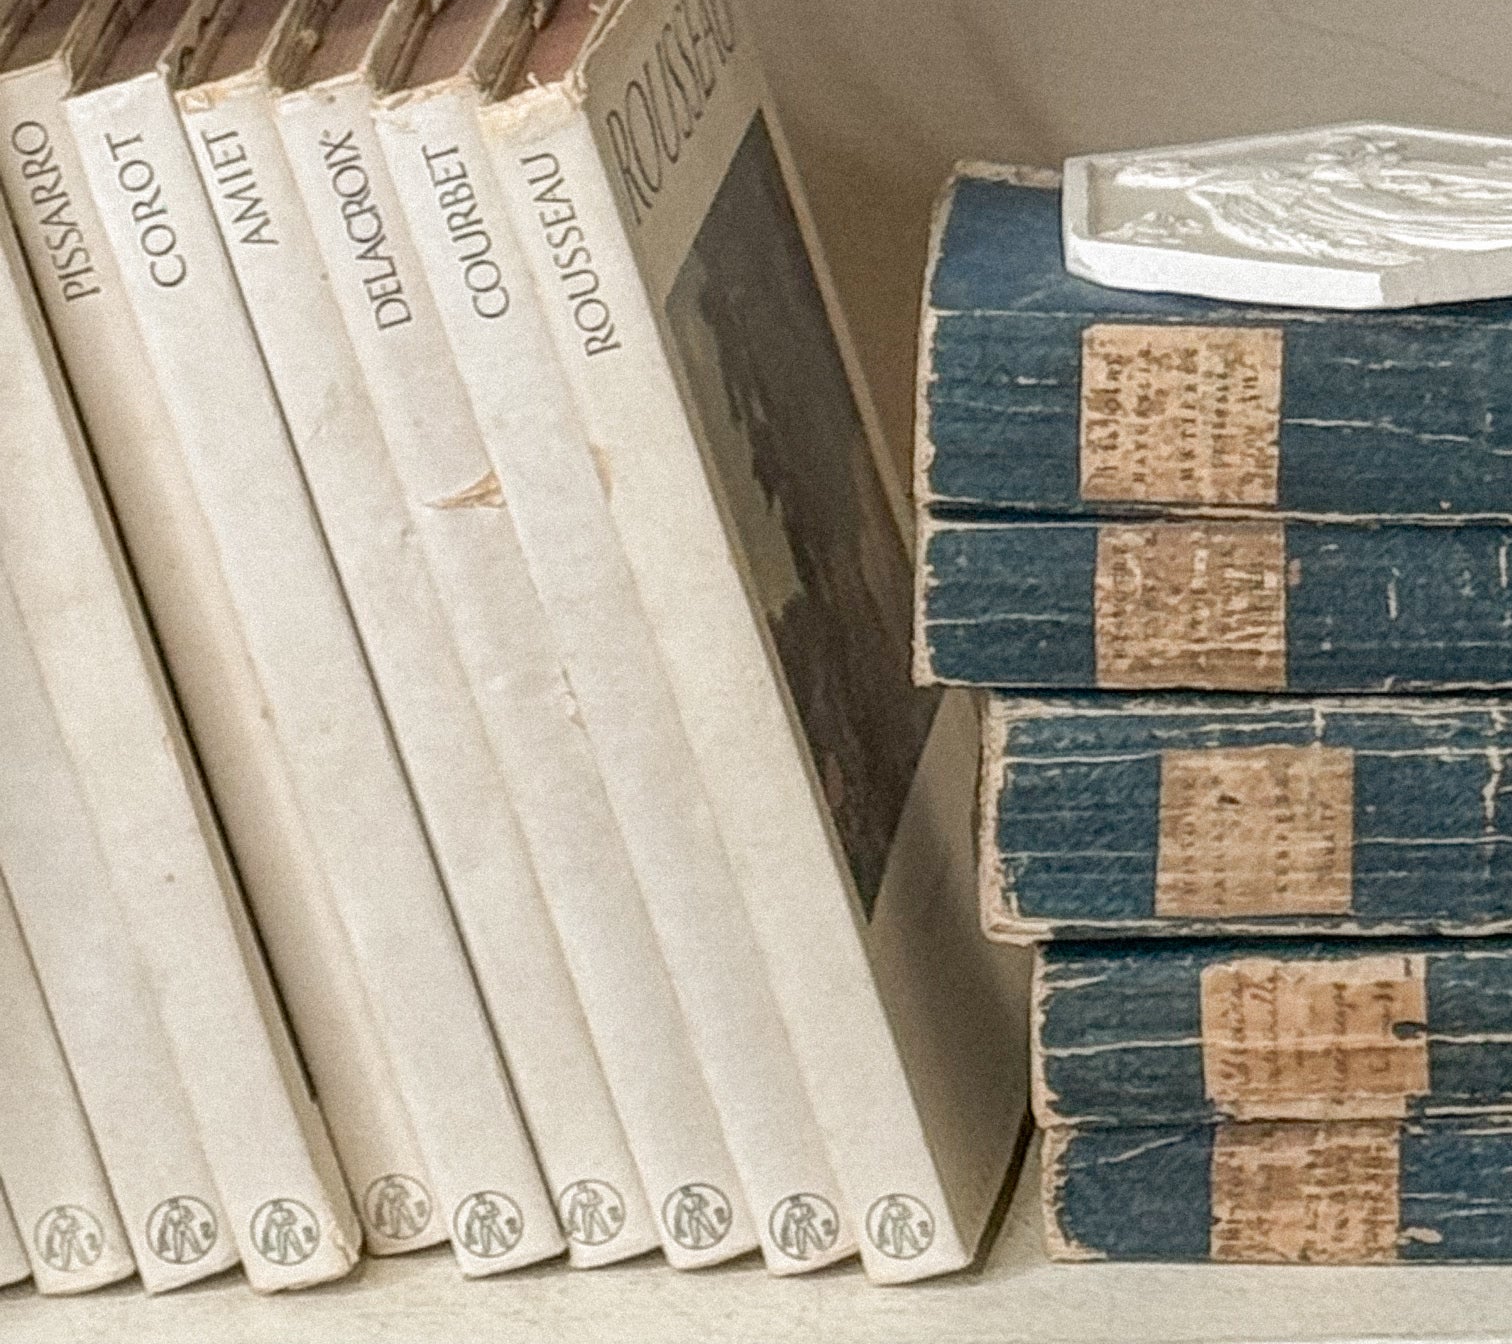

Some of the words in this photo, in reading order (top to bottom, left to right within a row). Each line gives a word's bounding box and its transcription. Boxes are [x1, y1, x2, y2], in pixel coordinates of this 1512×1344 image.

[11, 120, 102, 303] PISSARRO
[104, 129, 189, 290] COROT
[201, 128, 280, 249] AMIET
[320, 129, 414, 331] DELACROIX
[421, 143, 511, 321] COURBET
[520, 151, 623, 358] ROUSSEAU
